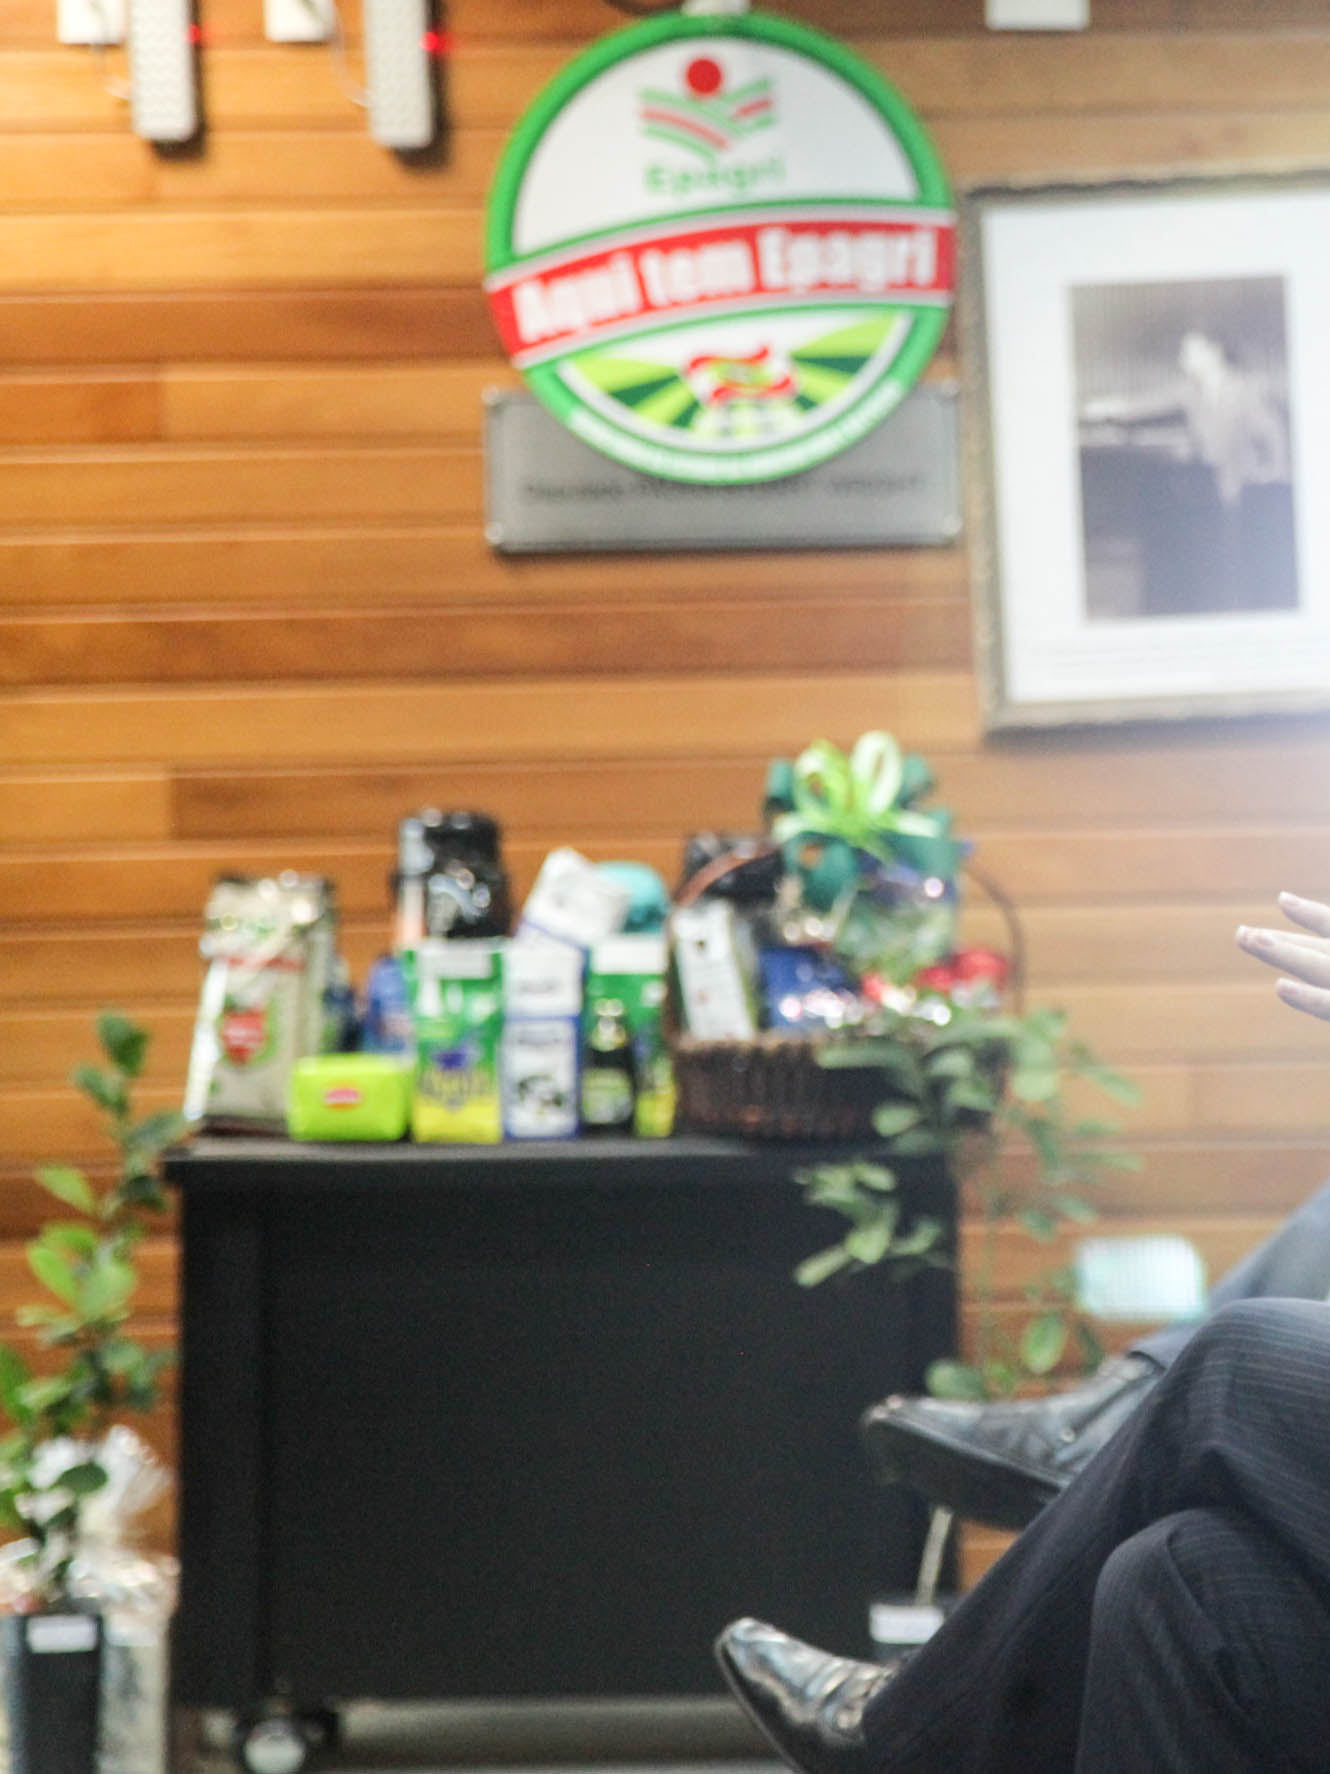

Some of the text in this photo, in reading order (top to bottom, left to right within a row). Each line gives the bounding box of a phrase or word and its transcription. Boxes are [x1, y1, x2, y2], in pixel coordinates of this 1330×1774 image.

[513, 226, 937, 344] Aqui tem Epagri
